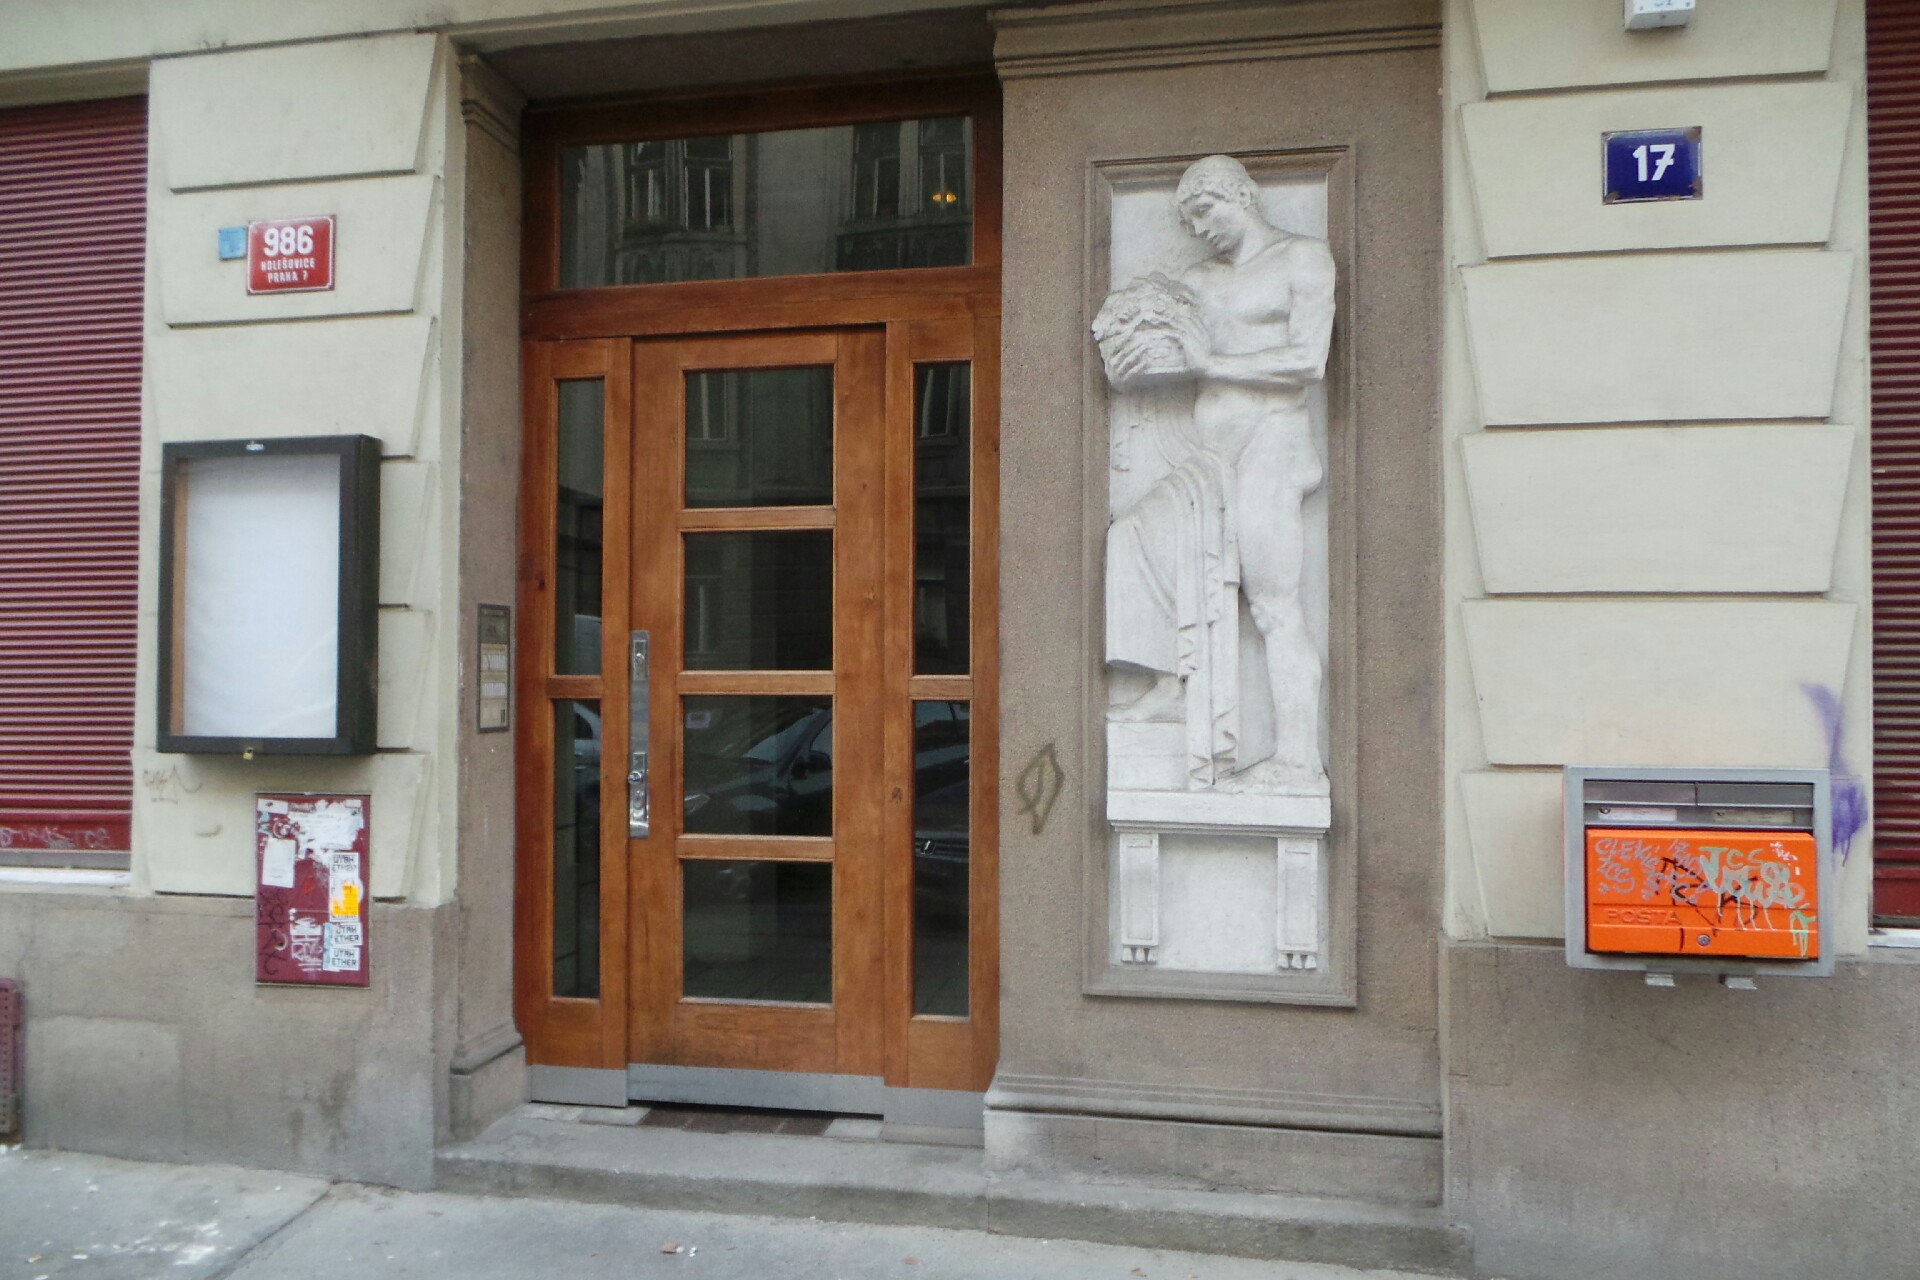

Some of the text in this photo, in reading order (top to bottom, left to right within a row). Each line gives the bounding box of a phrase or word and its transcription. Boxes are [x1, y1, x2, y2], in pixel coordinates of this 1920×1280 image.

[1632, 144, 1675, 182] 17
[264, 225, 313, 257] 986
[261, 257, 315, 271] HOLEŠOVICE
[267, 270, 309, 283] PRAHA 7
[335, 925, 357, 935] UTAH
[334, 935, 360, 944] ETHER
[333, 949, 355, 959] UTAH
[331, 959, 357, 968] ETHER
